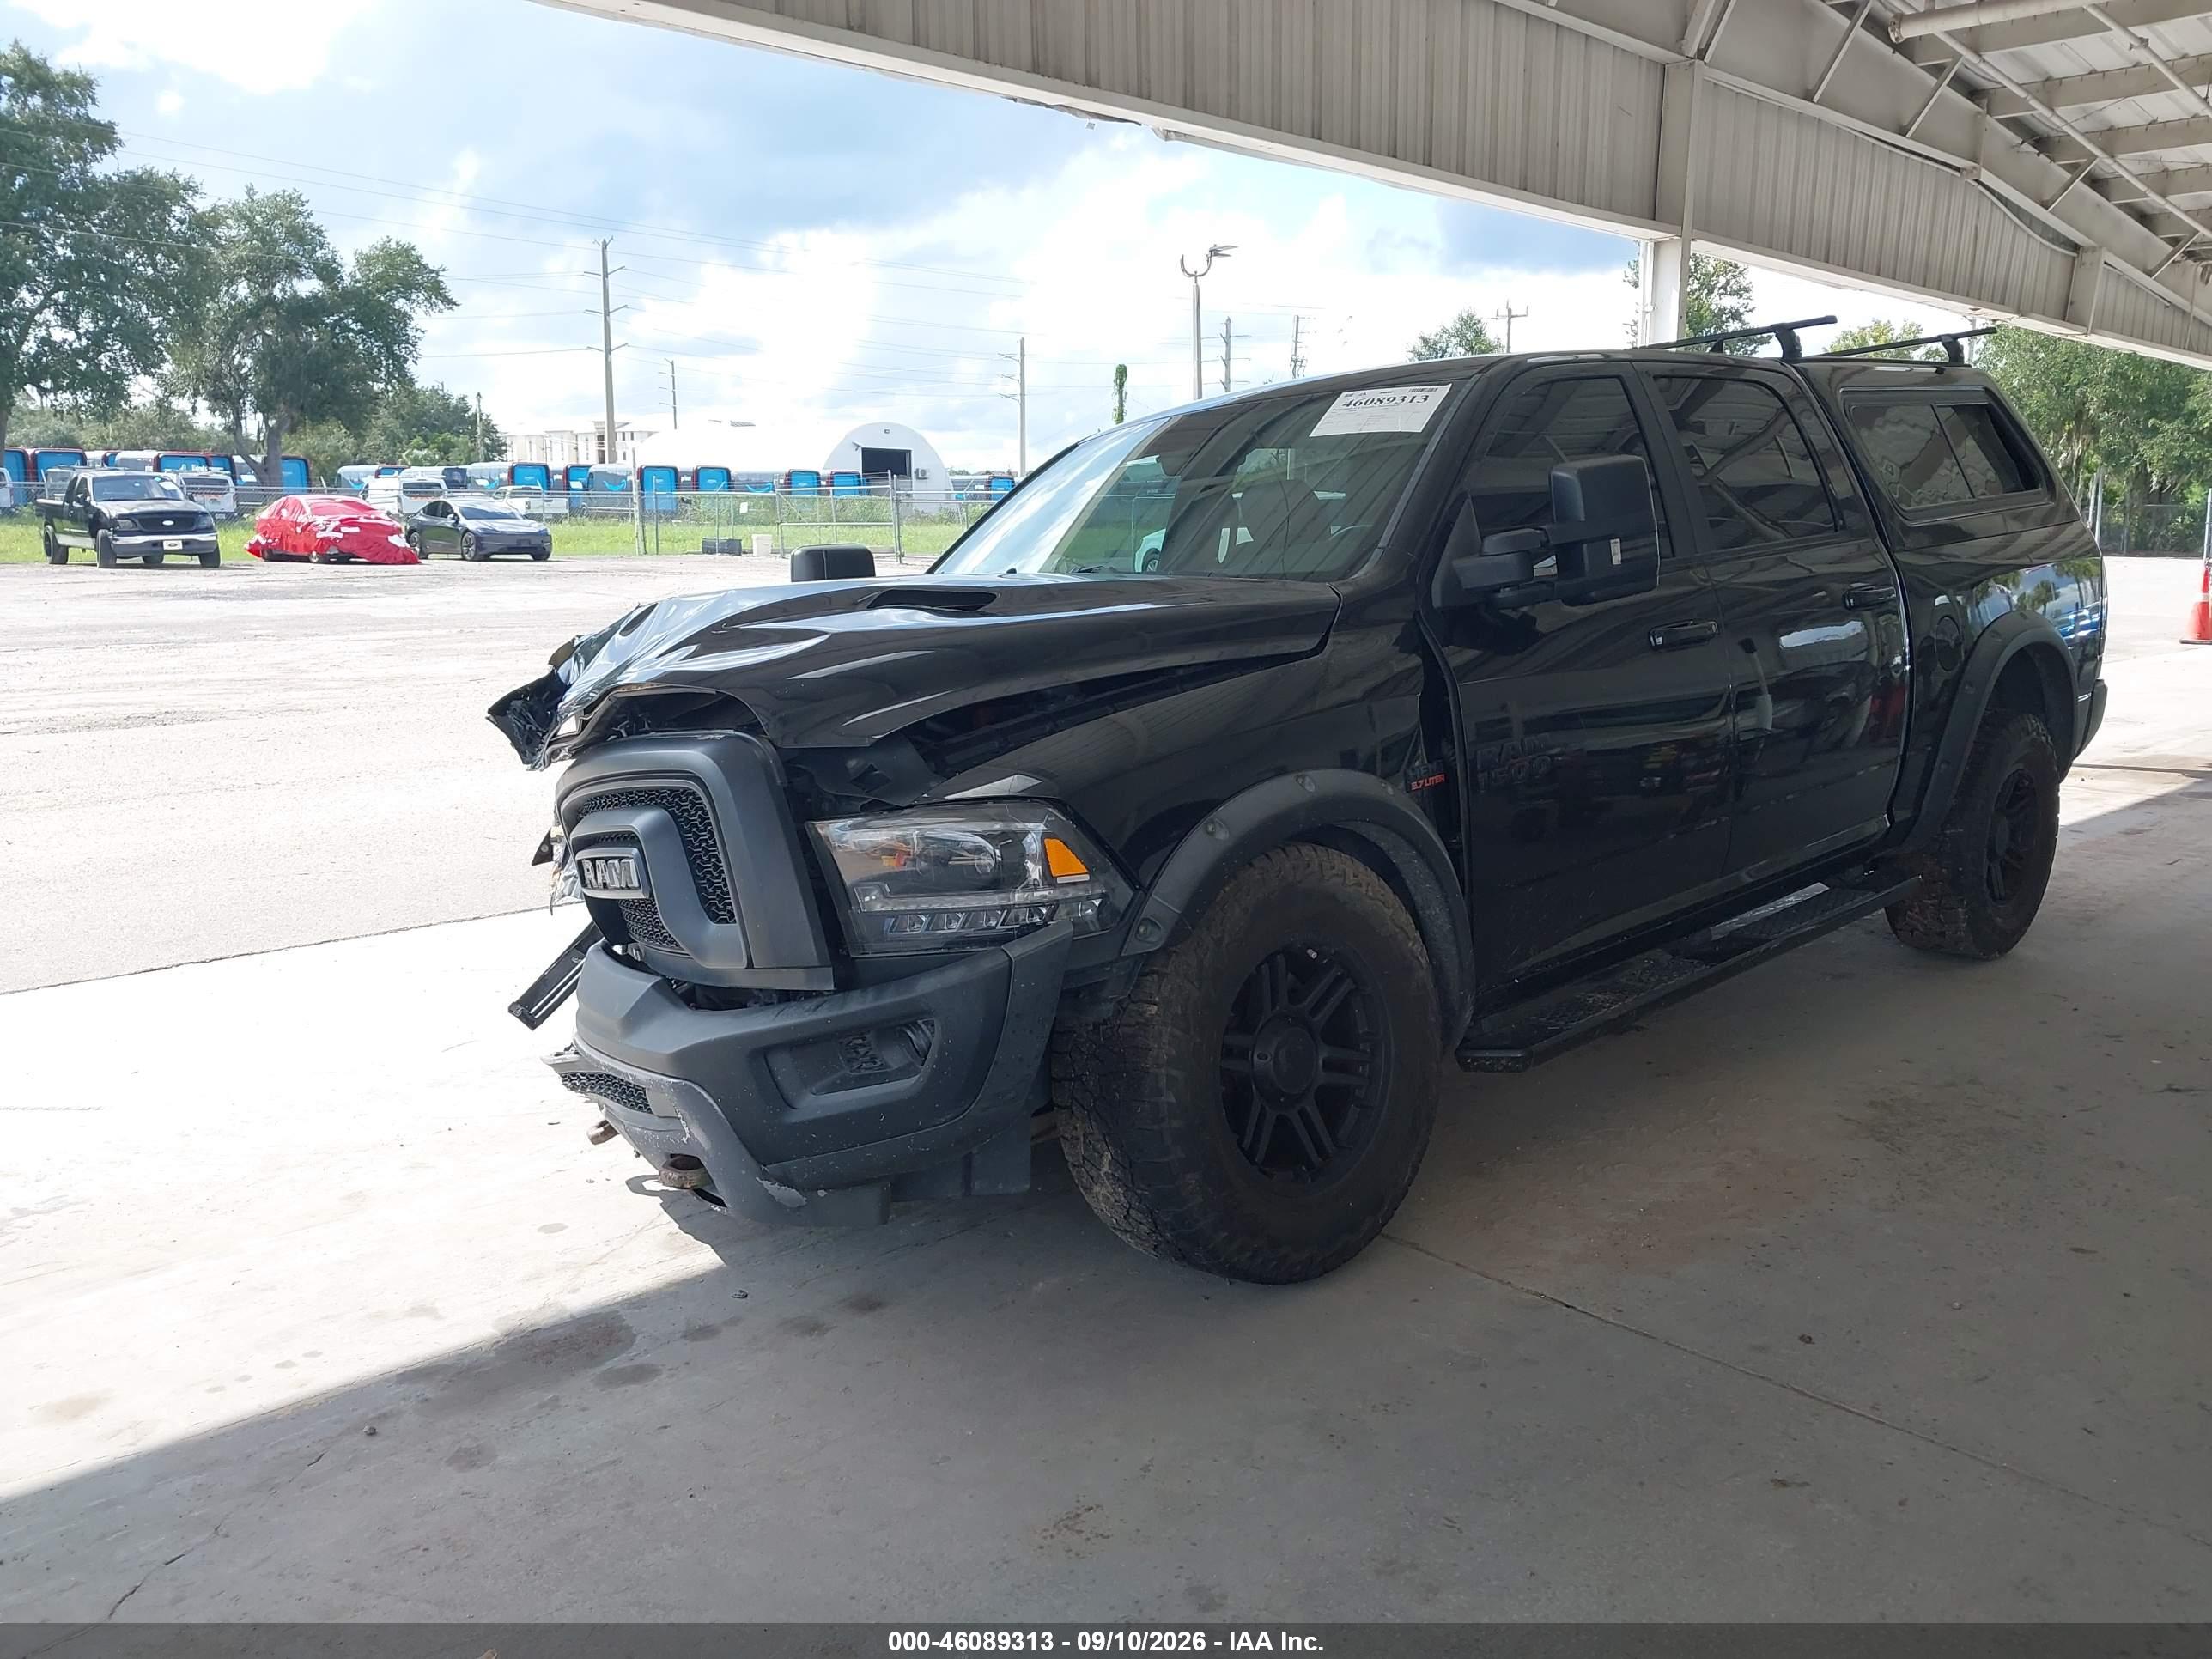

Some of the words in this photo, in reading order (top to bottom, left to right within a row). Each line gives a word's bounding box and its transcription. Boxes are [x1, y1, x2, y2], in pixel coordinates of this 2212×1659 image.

[1342, 394, 1430, 408] 46089313
[1425, 774, 1445, 787] LITER
[581, 859, 640, 890] RAM
